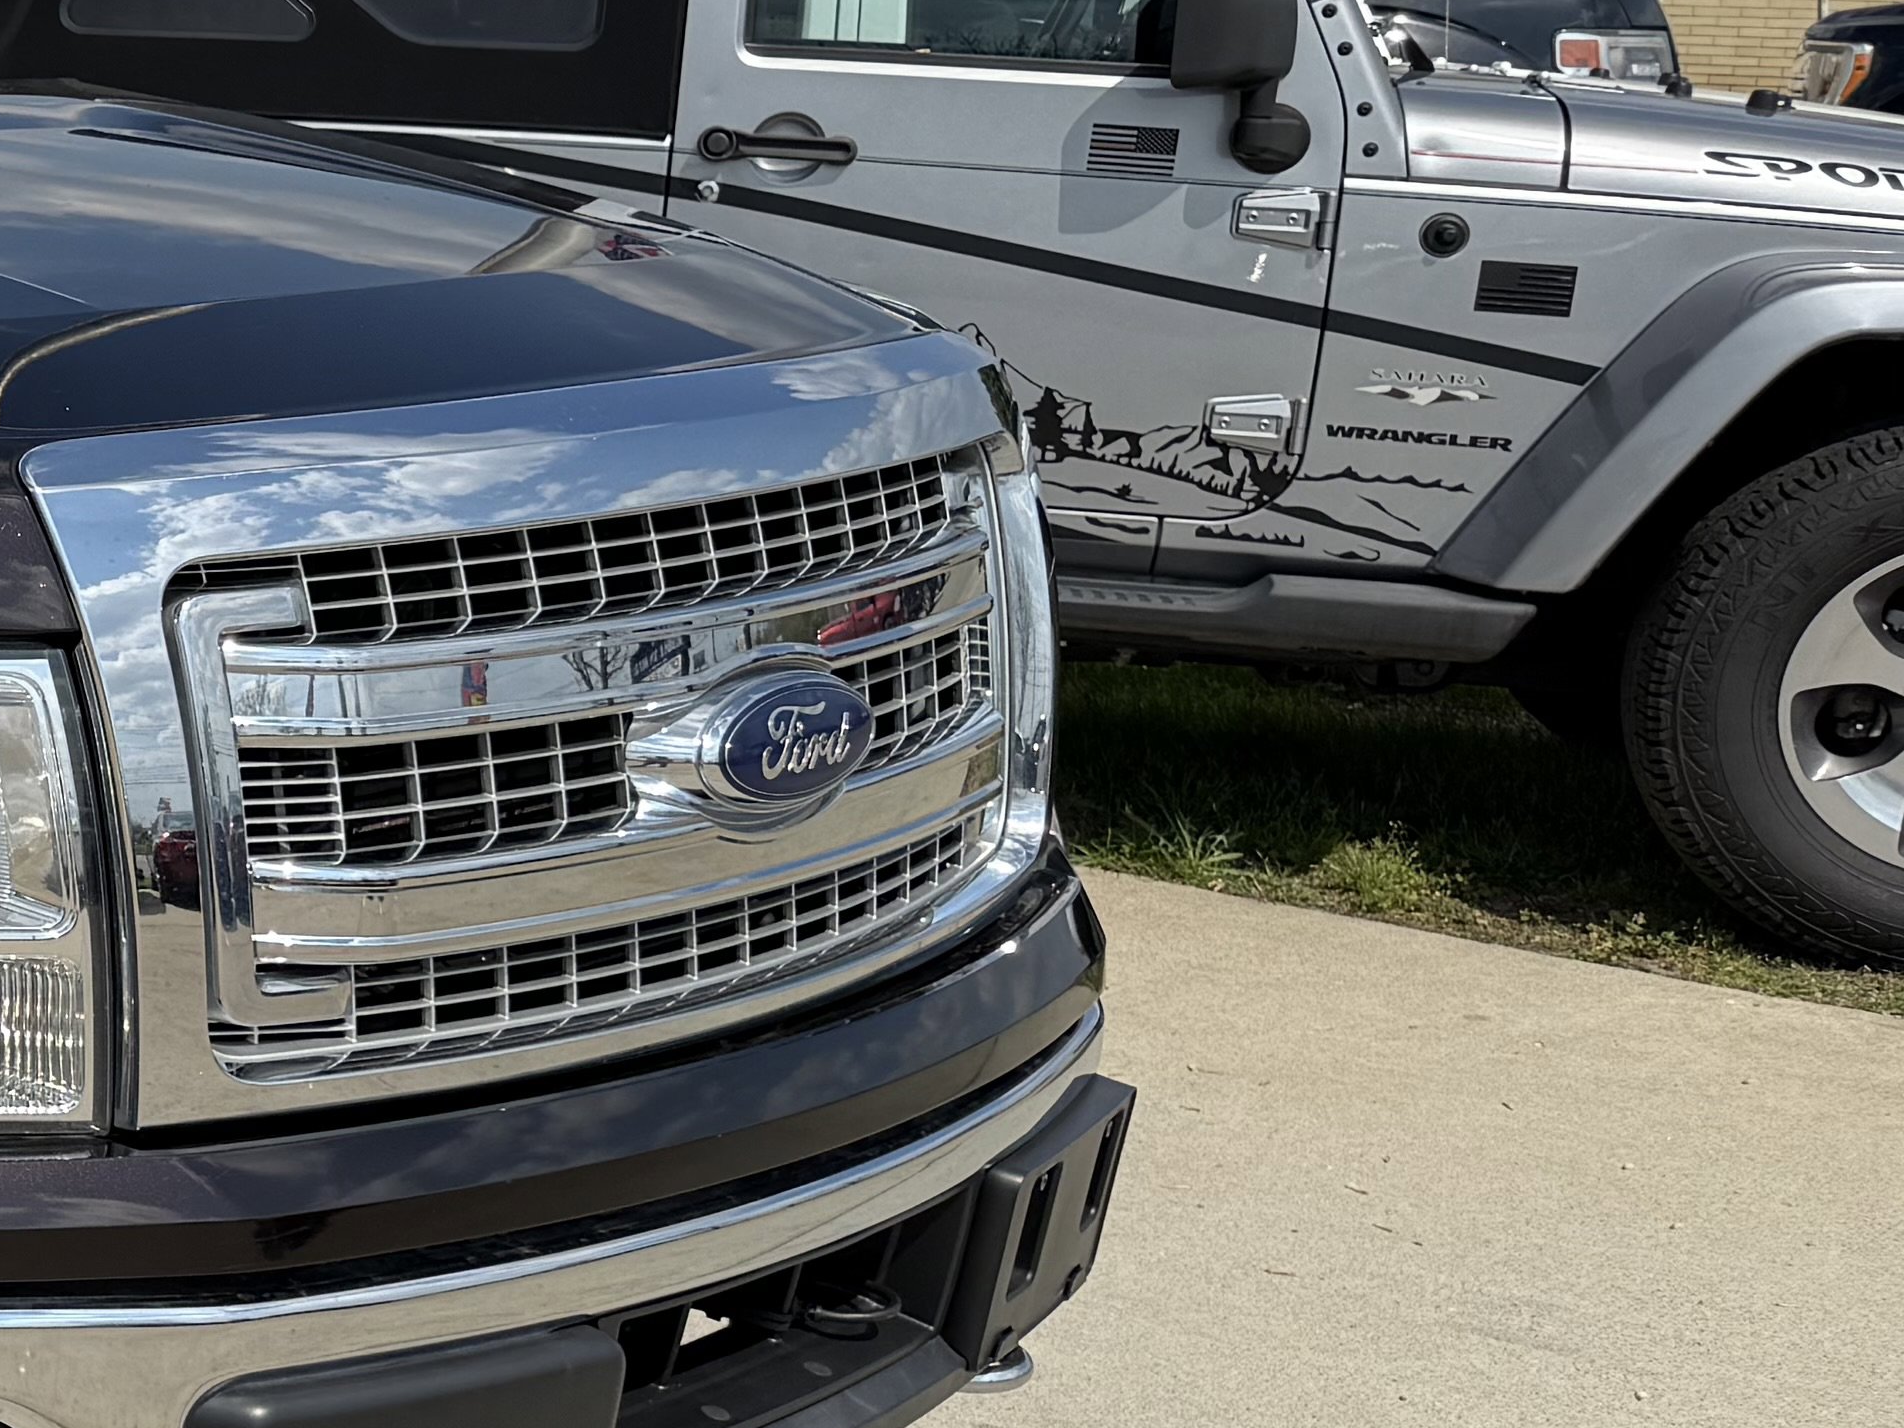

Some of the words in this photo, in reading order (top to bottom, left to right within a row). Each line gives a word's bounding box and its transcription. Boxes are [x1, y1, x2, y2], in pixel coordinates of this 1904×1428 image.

[1369, 368, 1490, 389] SAHARA
[1326, 424, 1512, 453] WRANGLER
[762, 701, 850, 780] Ford
